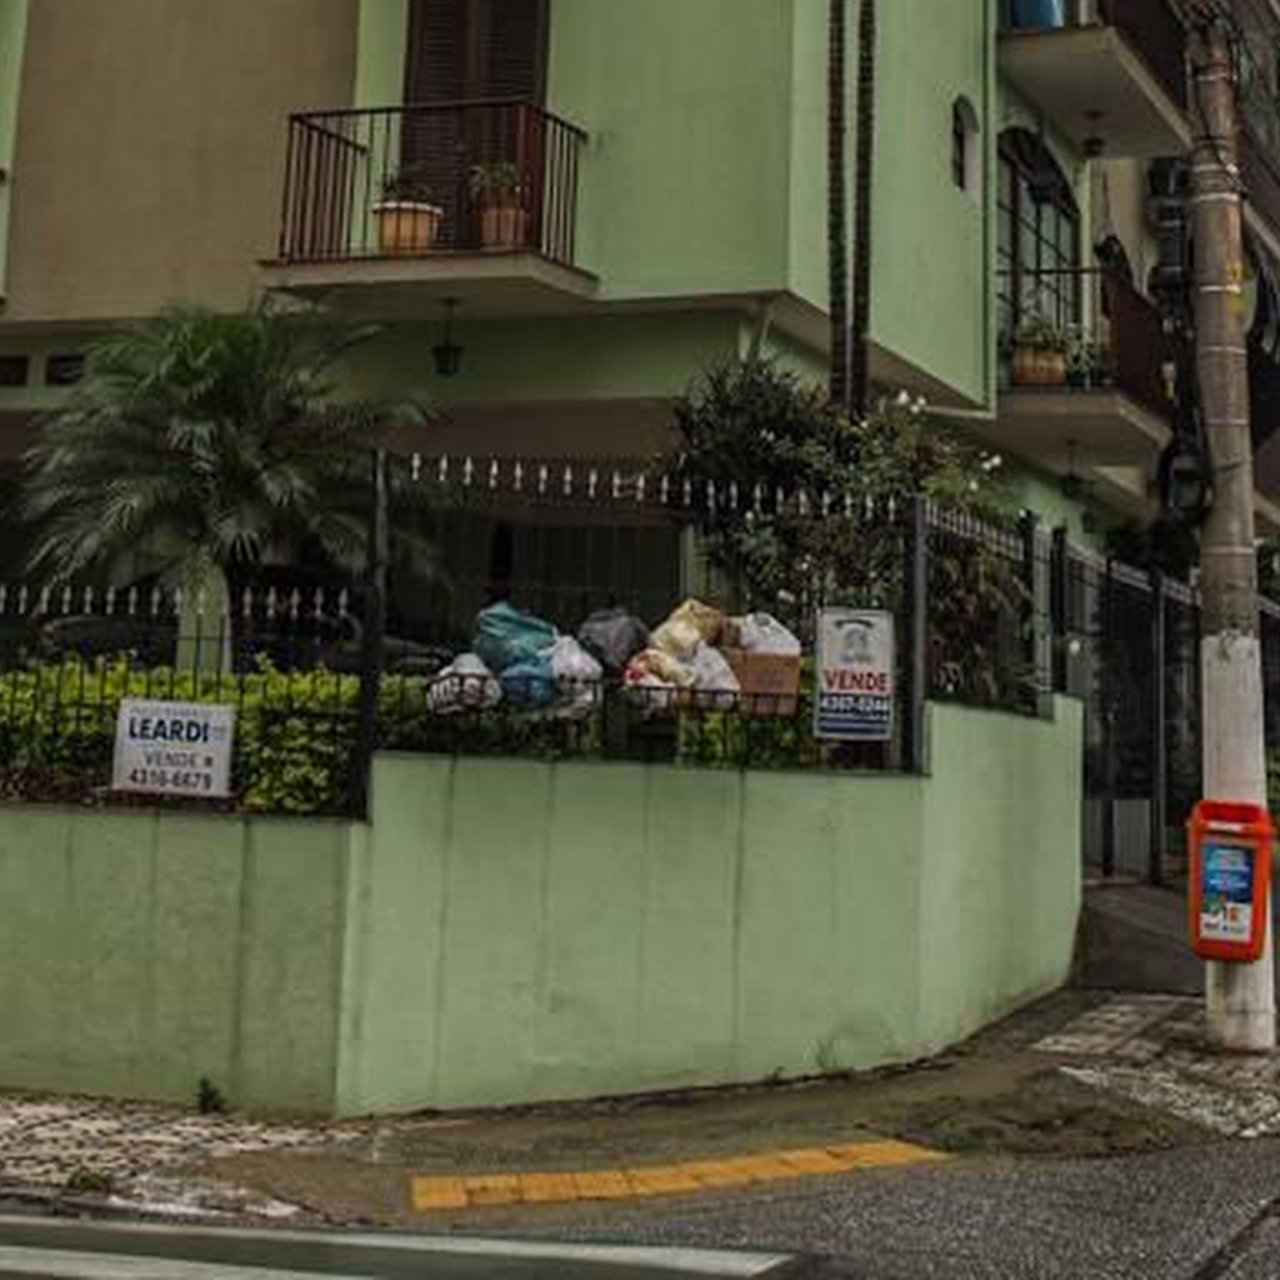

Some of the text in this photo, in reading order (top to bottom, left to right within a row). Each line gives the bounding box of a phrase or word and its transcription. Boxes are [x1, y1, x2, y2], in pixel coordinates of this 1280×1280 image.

[824, 669, 887, 692] VENDE
[129, 718, 209, 742] LEARDI
[144, 751, 198, 768] VENDE
